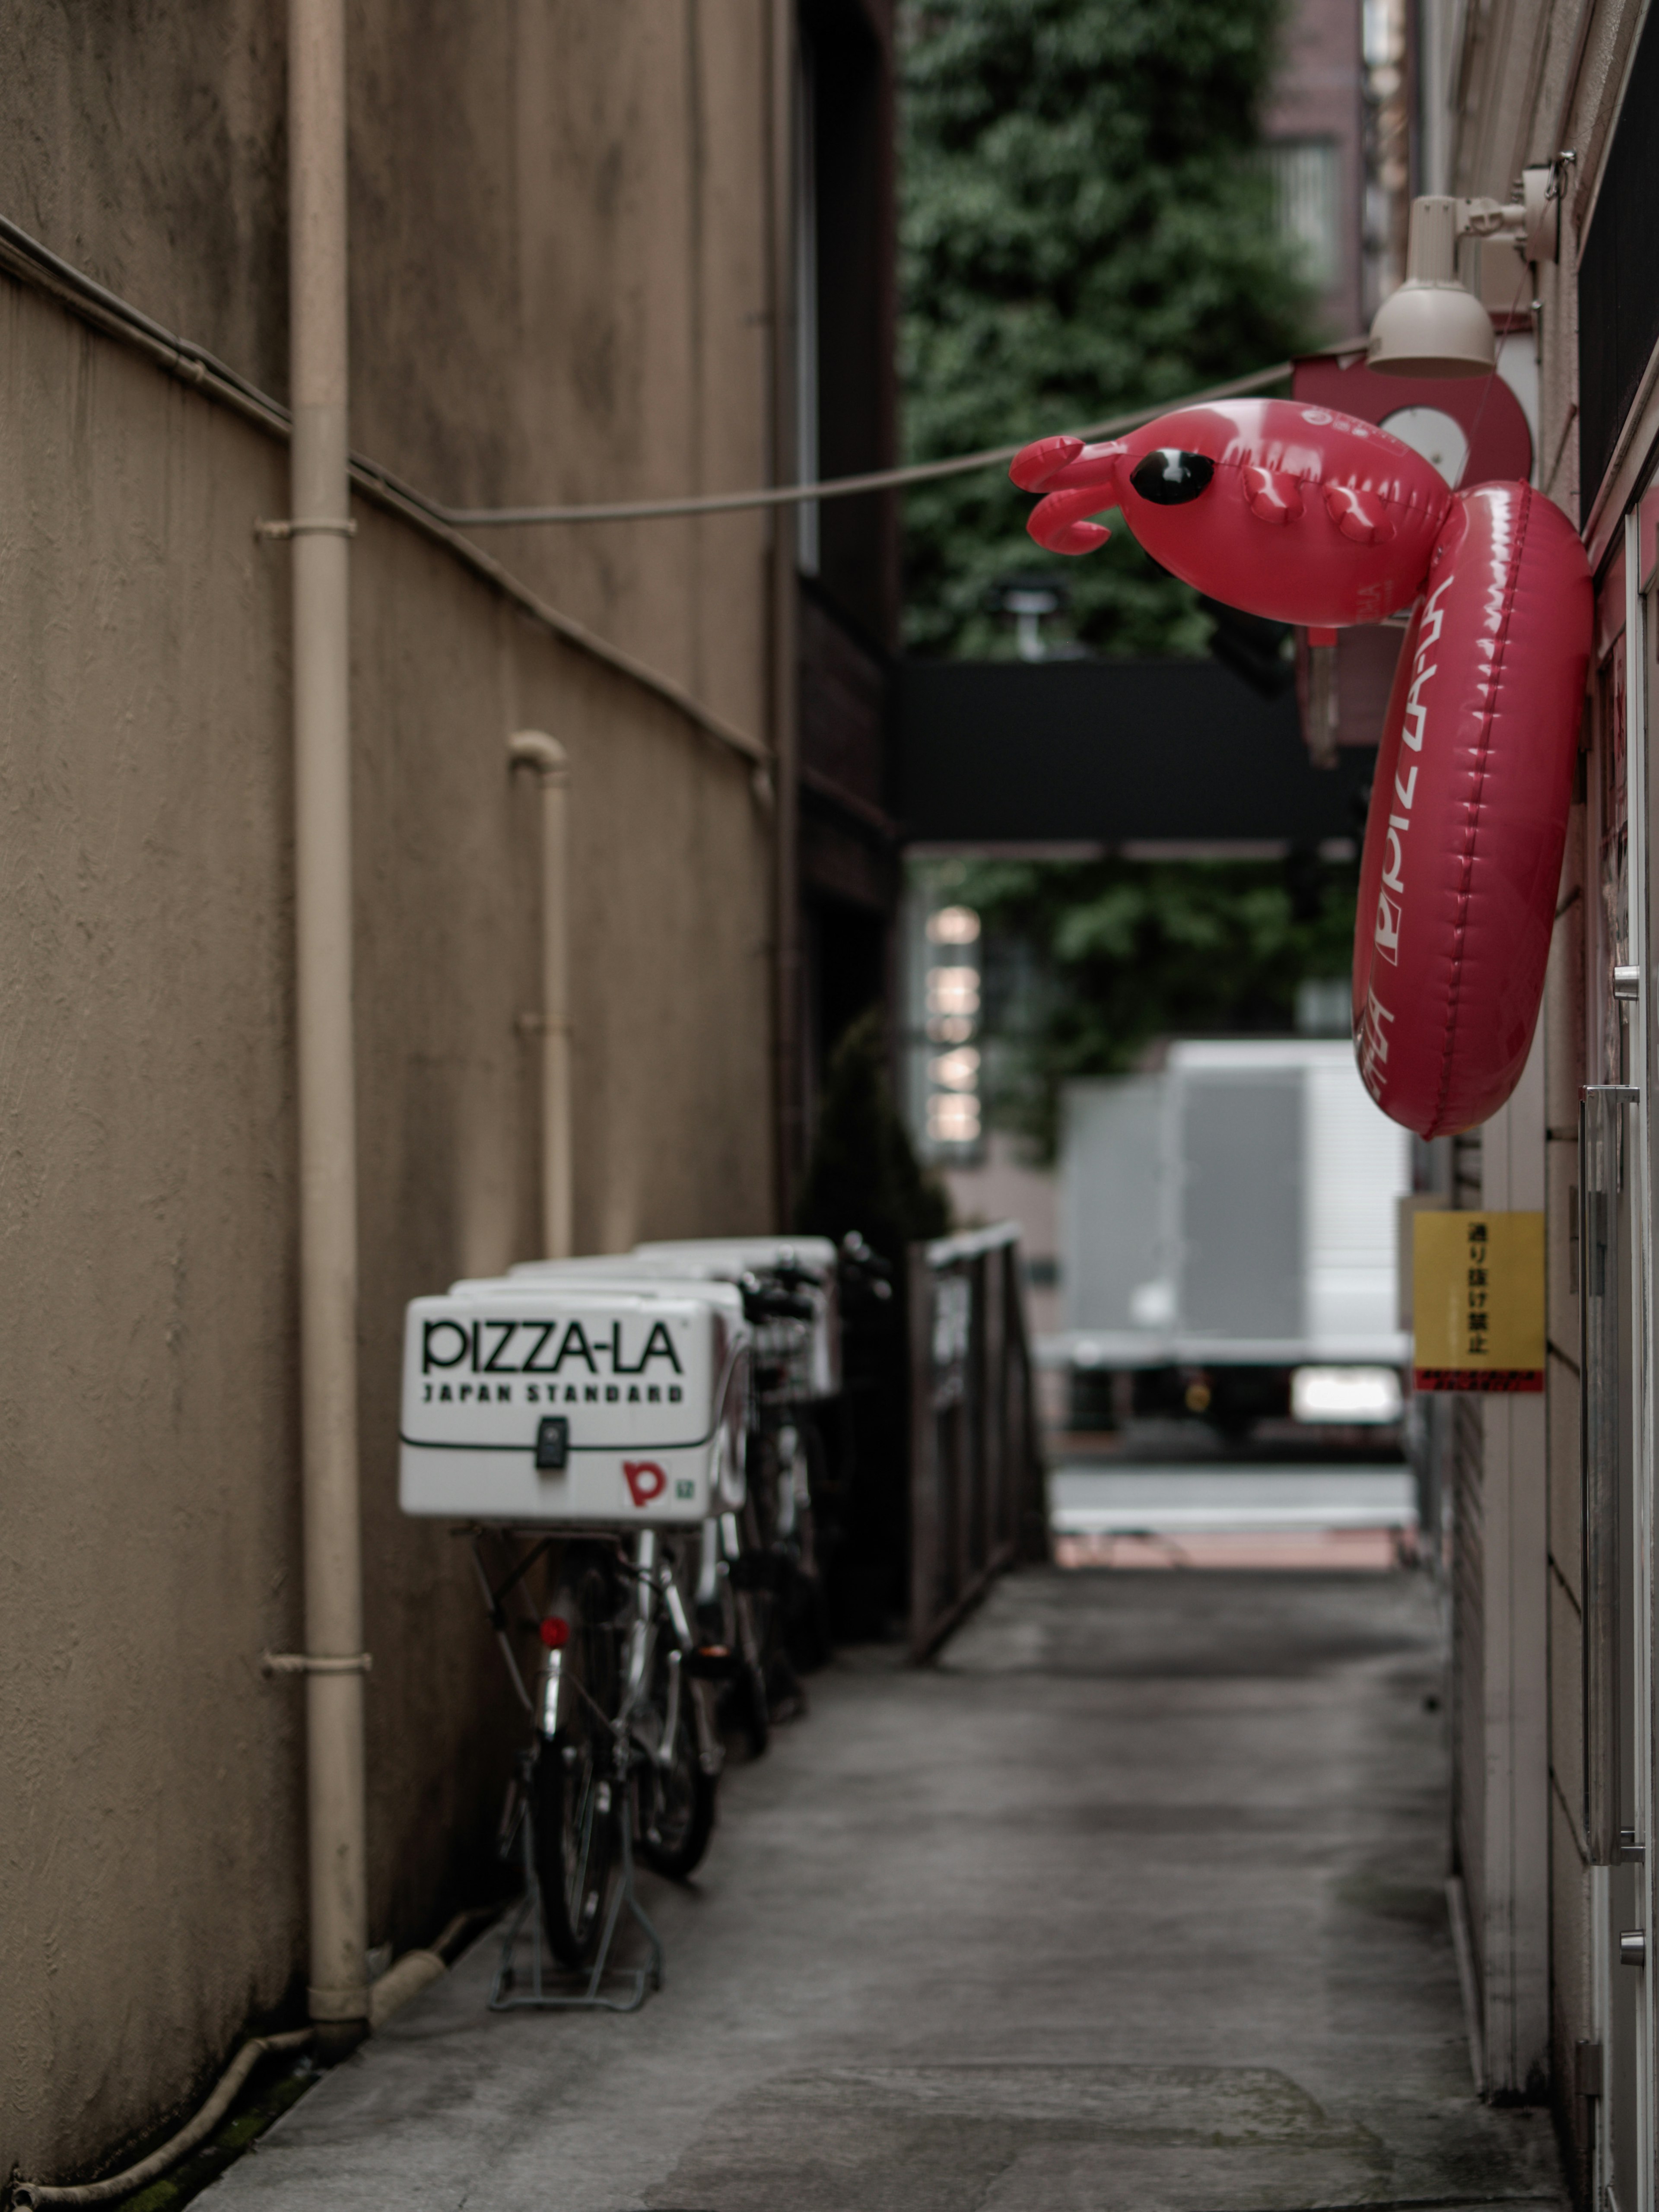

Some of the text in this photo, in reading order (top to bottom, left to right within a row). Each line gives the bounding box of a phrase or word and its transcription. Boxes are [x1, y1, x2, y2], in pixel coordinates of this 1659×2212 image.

[1467, 1222, 1488, 1355] 通り抜け禁止
[422, 1319, 683, 1375] PIZZA-LA
[424, 1383, 683, 1403] JAPAN STANDARD
